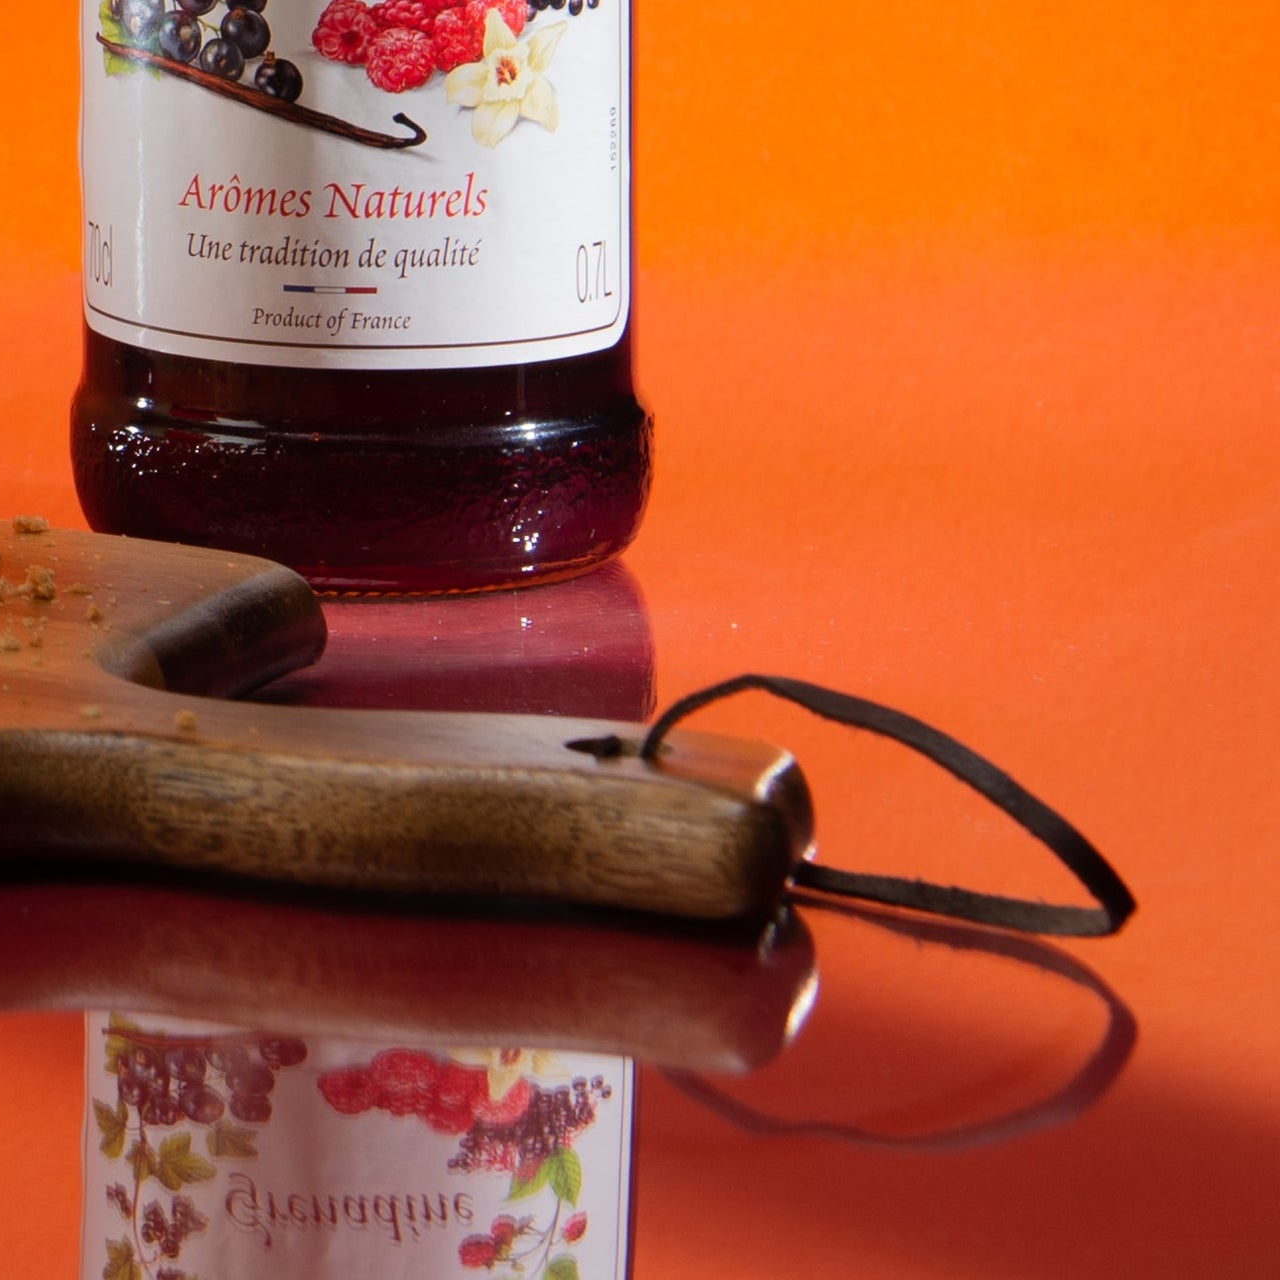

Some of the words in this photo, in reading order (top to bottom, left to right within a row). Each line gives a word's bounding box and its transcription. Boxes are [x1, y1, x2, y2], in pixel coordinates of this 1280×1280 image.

[178, 174, 312, 218] Arômes
[323, 172, 488, 219] Naturels
[87, 220, 113, 288] 70cl
[187, 233, 233, 261] Une
[239, 236, 350, 268] tradition
[358, 238, 387, 268] de
[393, 238, 483, 279] qualité
[575, 239, 613, 304] 0.7L
[252, 306, 322, 329] Product
[326, 307, 349, 337] of
[351, 312, 412, 330] France
